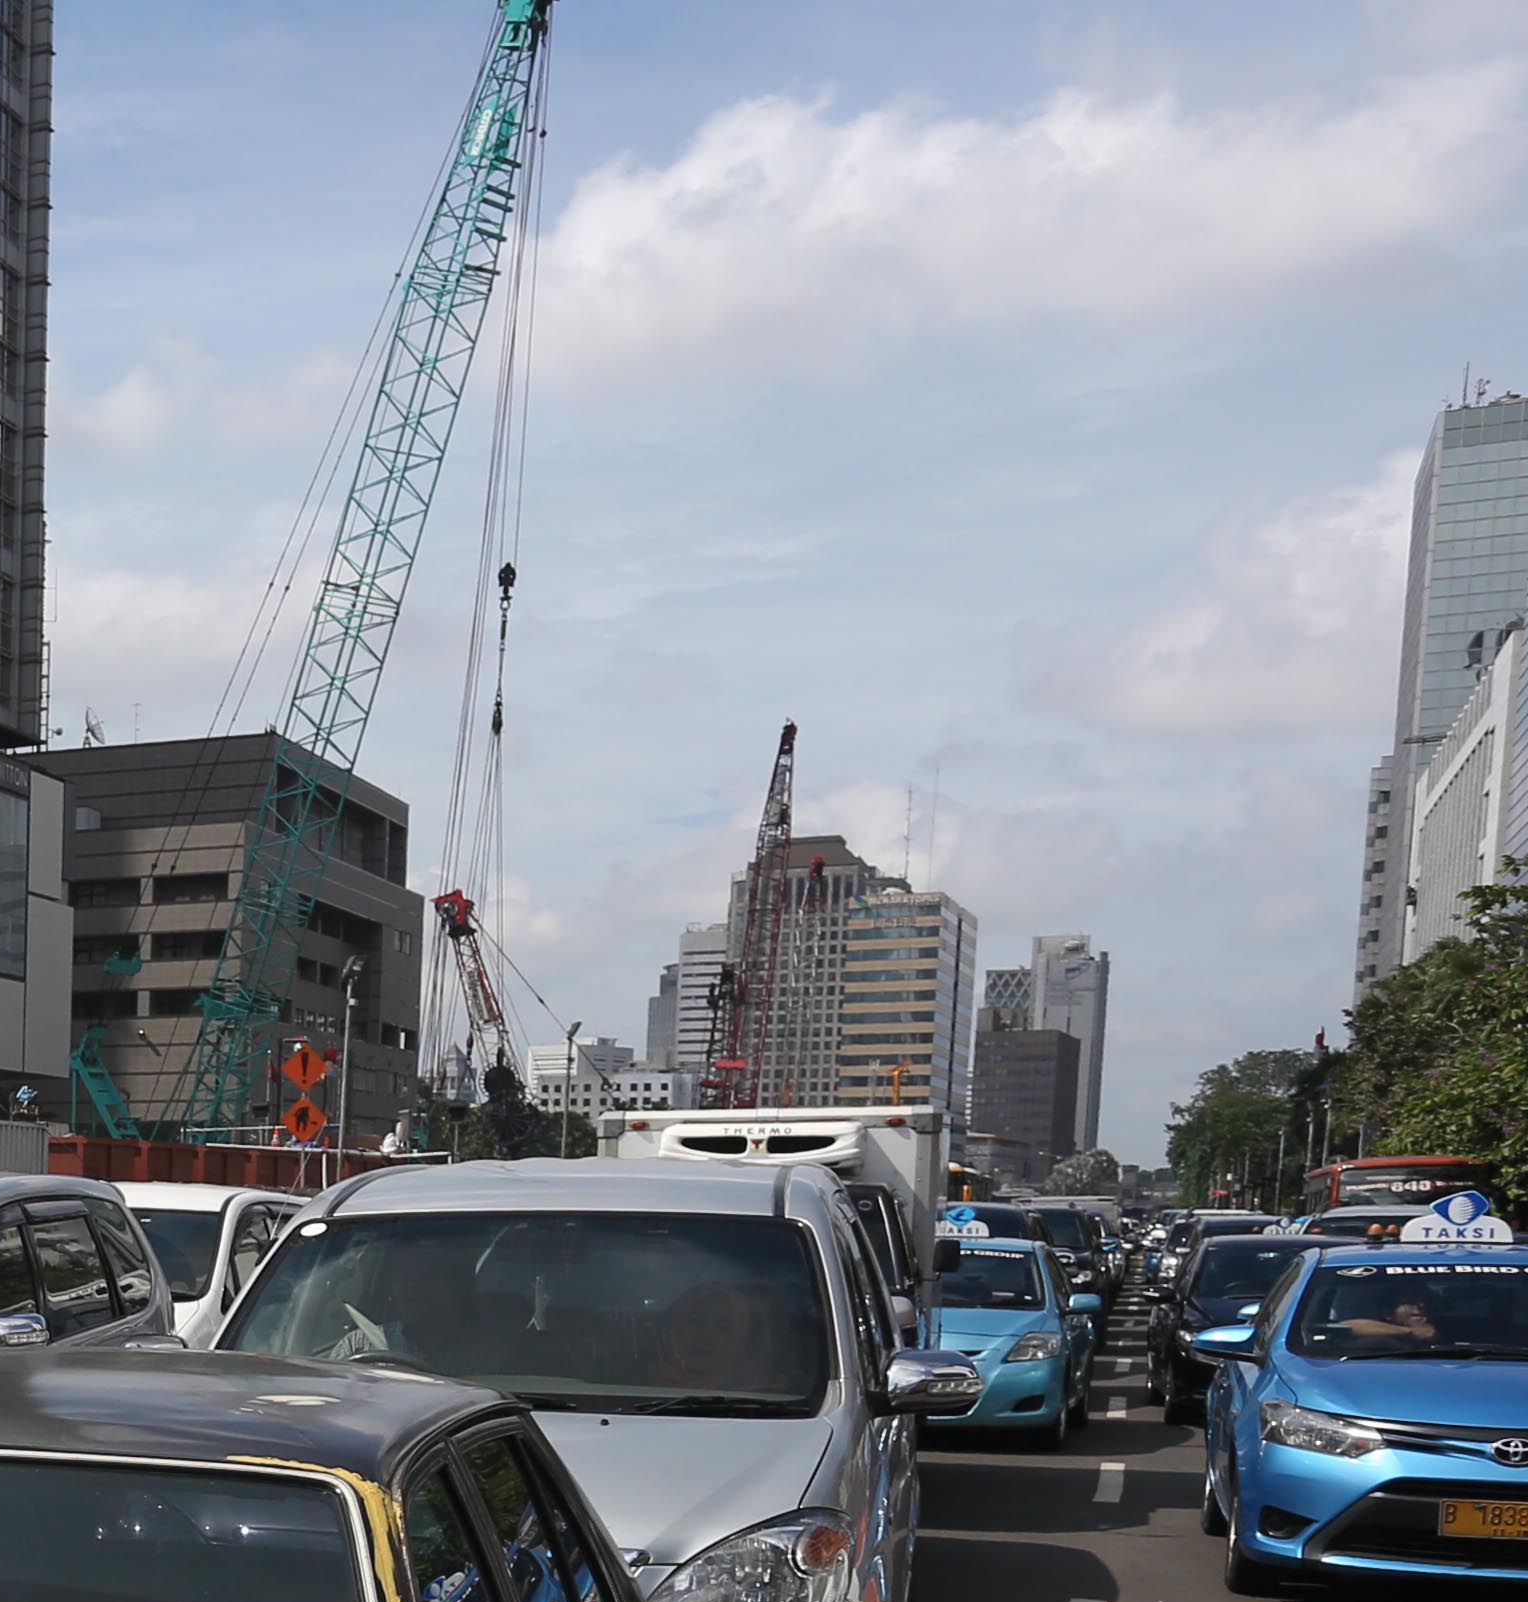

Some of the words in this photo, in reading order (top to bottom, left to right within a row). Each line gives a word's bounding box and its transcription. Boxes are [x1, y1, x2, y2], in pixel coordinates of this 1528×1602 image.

[722, 1127, 793, 1135] THERMO
[941, 1226, 980, 1235] AKSI
[1422, 1227, 1494, 1239] TAKSI
[1384, 1265, 1452, 1275] BLUE
[1455, 1265, 1521, 1275] BIRD
[1445, 1503, 1457, 1524] B
